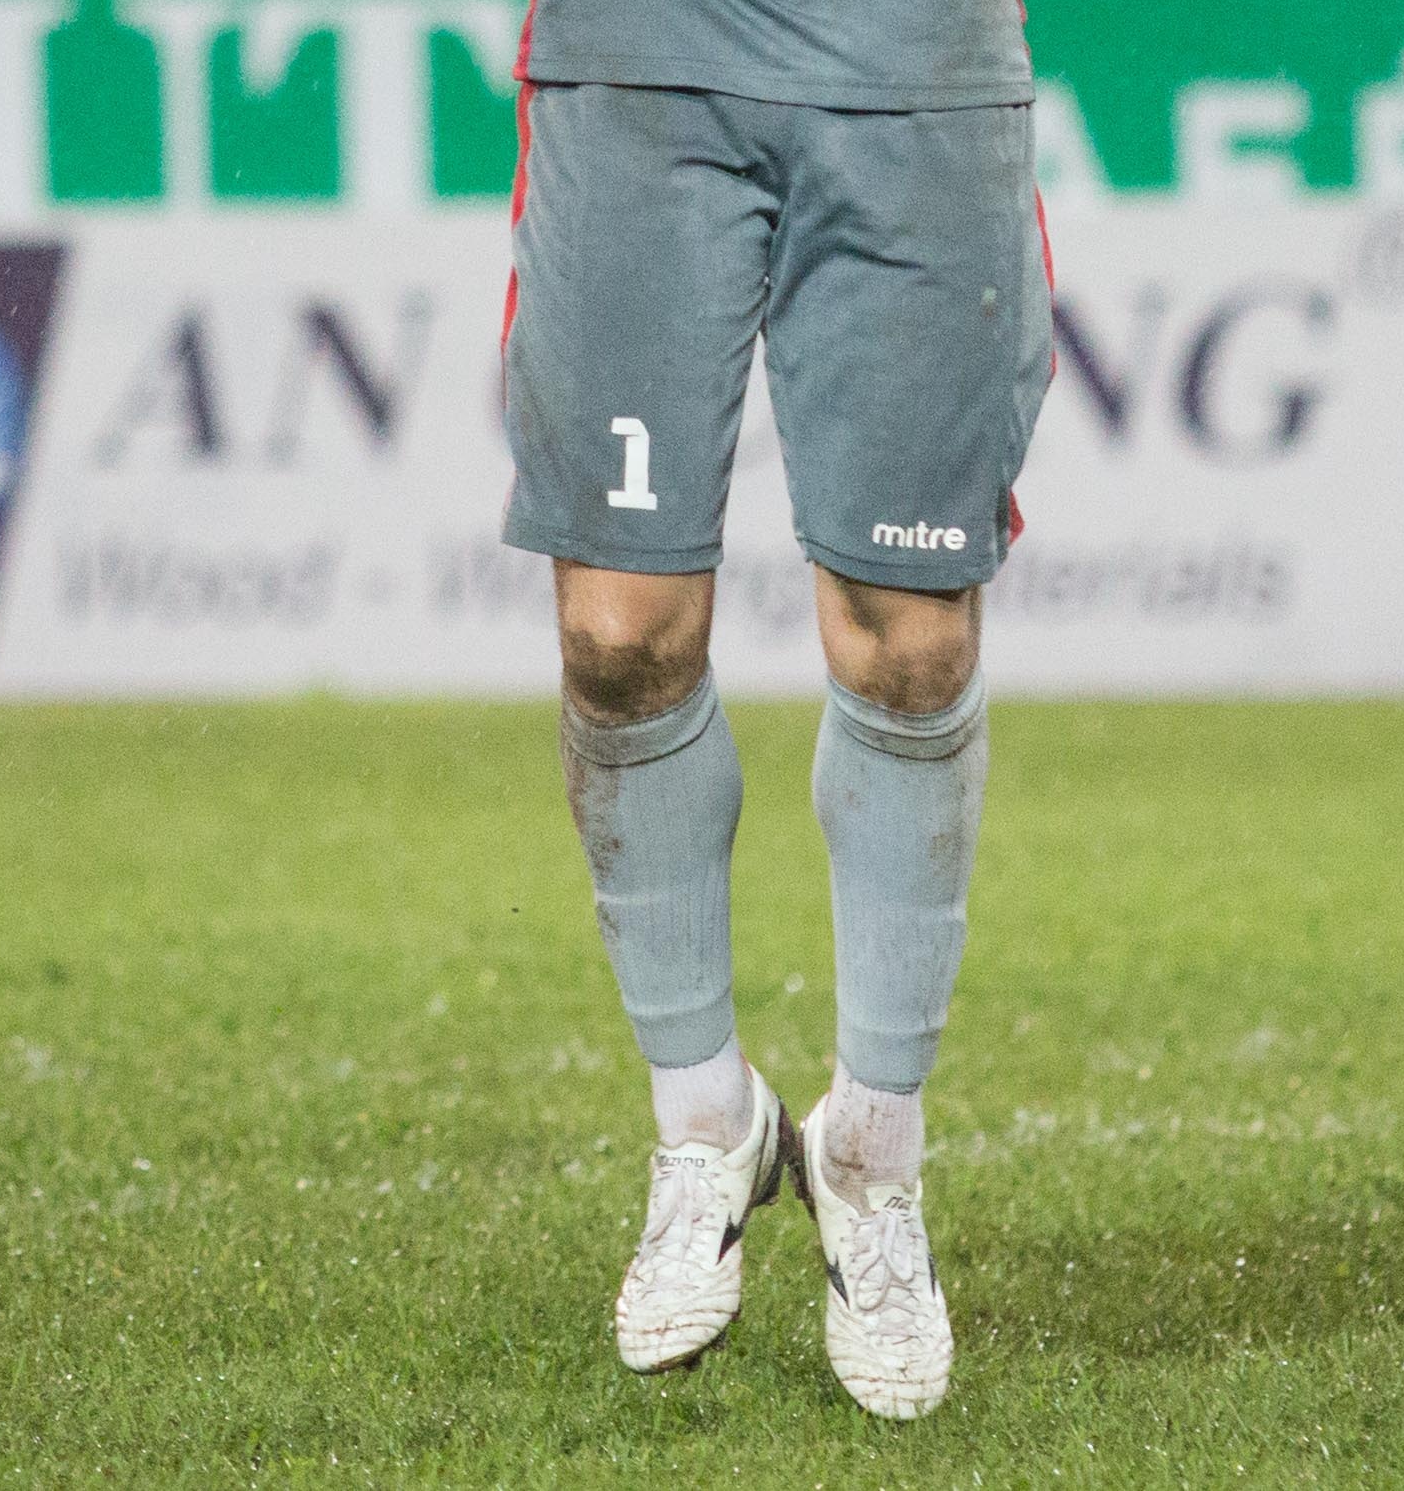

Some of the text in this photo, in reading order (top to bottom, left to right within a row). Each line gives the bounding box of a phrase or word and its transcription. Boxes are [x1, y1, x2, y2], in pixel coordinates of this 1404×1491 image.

[89, 289, 435, 471] AN
[607, 417, 658, 510] 1
[872, 520, 967, 551] mitre
